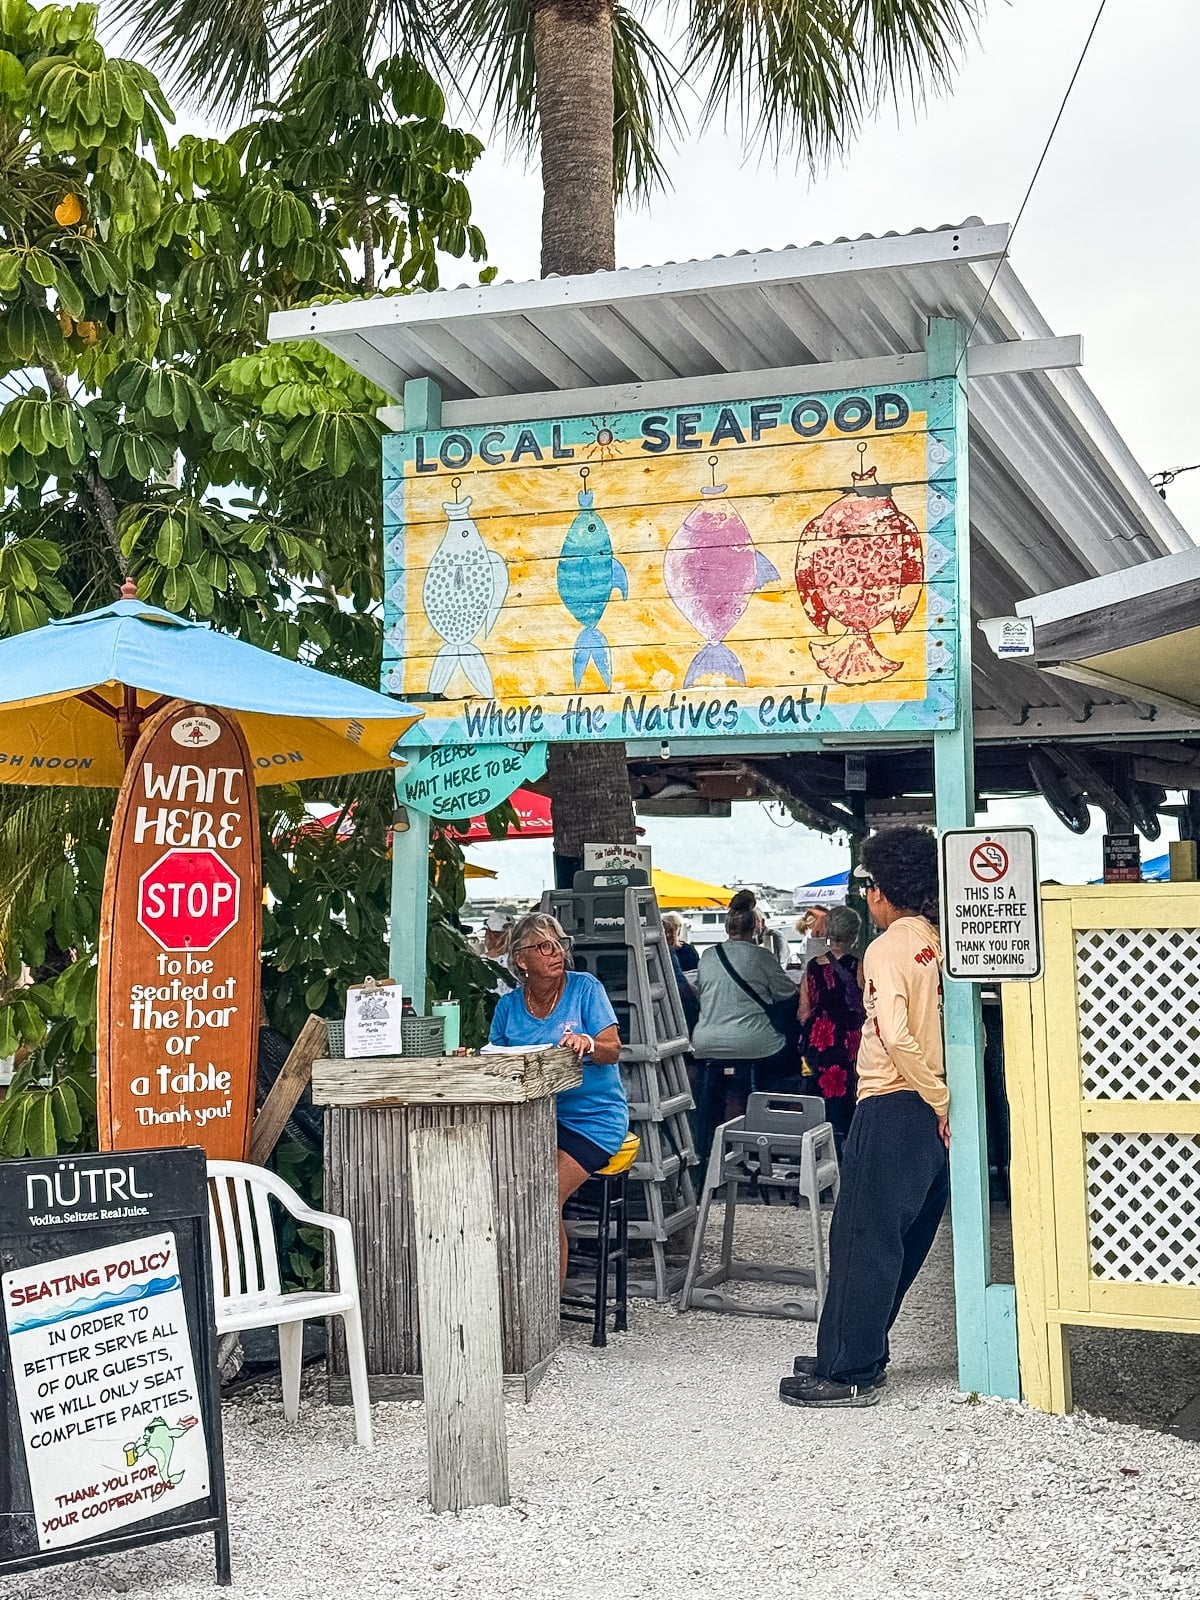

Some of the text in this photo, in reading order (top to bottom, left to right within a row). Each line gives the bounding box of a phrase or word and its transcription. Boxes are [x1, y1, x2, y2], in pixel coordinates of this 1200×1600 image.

[415, 393, 909, 473] LOCAL SEAFOOD
[464, 685, 828, 738] Where the Natives eat!
[29, 756, 94, 769] NOON
[256, 751, 304, 768] OON
[429, 743, 478, 770] PLEASE
[143, 762, 243, 805] WAIT
[405, 756, 522, 802] WAIT HERE TO BE
[432, 788, 491, 815] SEATED
[133, 806, 242, 849] HERE
[145, 881, 233, 919] STOP
[964, 886, 1016, 900] THIS IS A
[955, 903, 1027, 918] SMOKE-FREE
[961, 920, 1021, 934] PROPERTY
[914, 945, 936, 967] TID
[955, 939, 1030, 951] THANK YOU FOR
[156, 952, 214, 976] to be
[961, 954, 1025, 965] NOT SMOKING
[130, 976, 237, 1001] seated at
[129, 1000, 239, 1030] the bar
[165, 1035, 201, 1056] or
[130, 1076, 150, 1096] a
[135, 1099, 233, 1127] Thank you!
[10, 1250, 171, 1307] SEATING POLICY
[48, 1306, 149, 1346] IN ORDER TO
[23, 1323, 178, 1377] BETTER SERVE ALL
[37, 1348, 173, 1398] OF OUR GUESTS,
[30, 1366, 184, 1424] WE WILL ONLY SEAT
[30, 1389, 193, 1449] COMPLETE PARTIES.
[55, 1465, 158, 1508] THANK YOU FOR
[42, 1511, 79, 1533] YOUR
